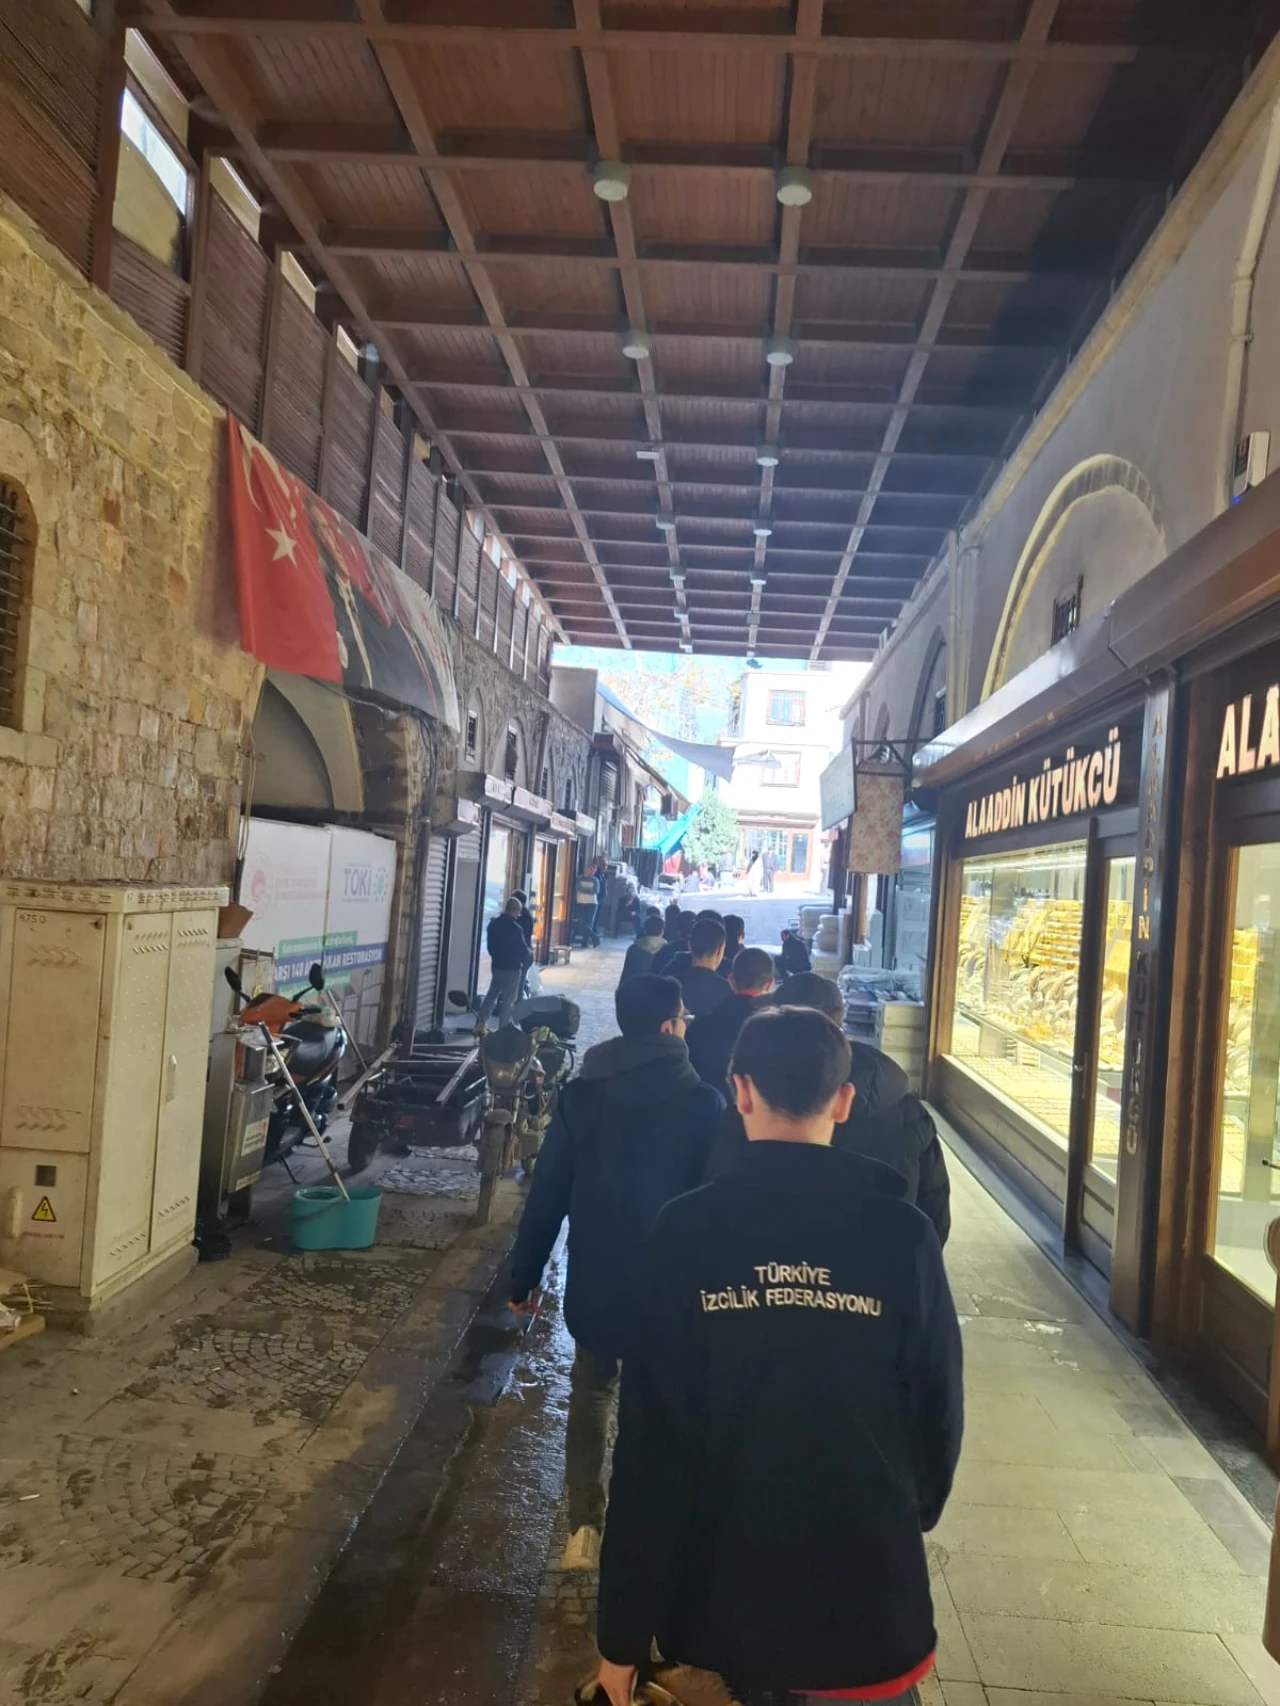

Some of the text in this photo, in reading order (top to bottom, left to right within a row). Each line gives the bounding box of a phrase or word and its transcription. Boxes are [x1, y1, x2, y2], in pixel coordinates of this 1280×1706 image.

[965, 726, 1121, 839] ALAADDİN KÜTÜKÇÜ
[753, 1261, 832, 1286] TÜRKİYE
[699, 1285, 882, 1317] İZCİLİK FEDERASYONU
